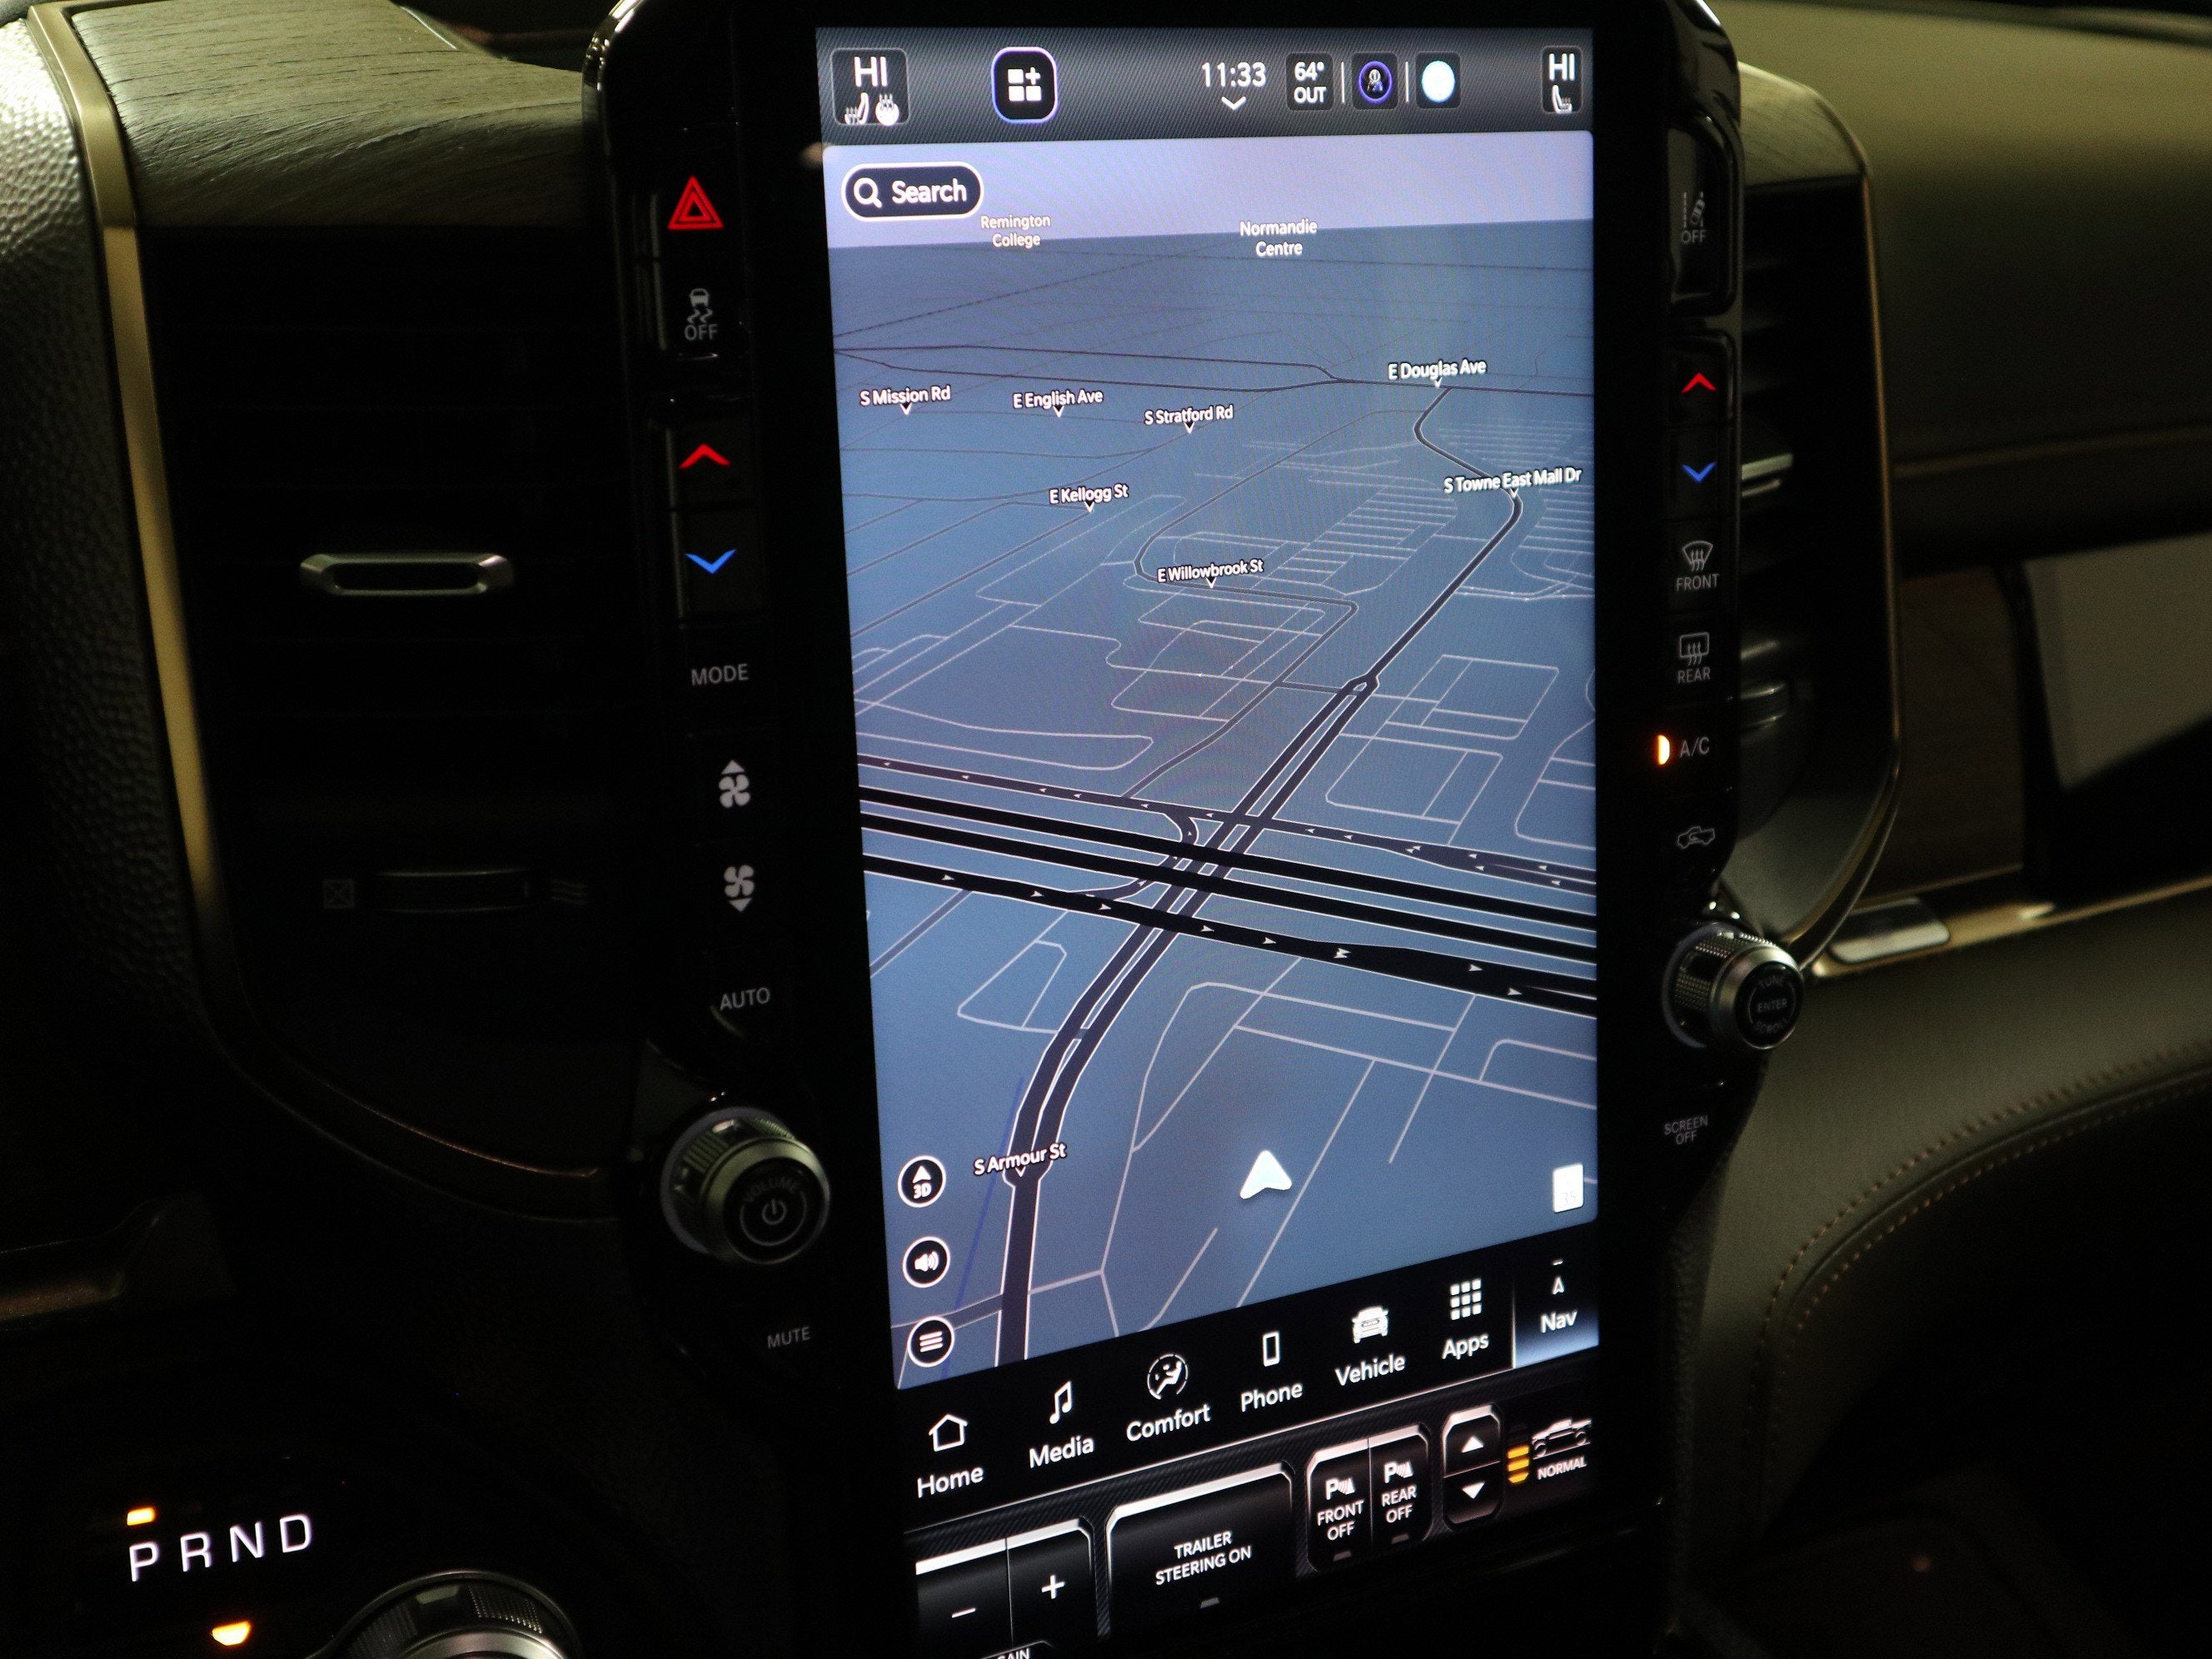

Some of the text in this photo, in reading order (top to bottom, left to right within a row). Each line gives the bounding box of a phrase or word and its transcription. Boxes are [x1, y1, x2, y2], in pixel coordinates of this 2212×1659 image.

[854, 56, 888, 87] HI
[1201, 62, 1267, 87] 11:33
[1293, 61, 1325, 81] 64°
[1549, 52, 1576, 81] HI
[1293, 85, 1327, 104] OUT
[891, 177, 967, 205] Search
[980, 214, 1051, 232] Remington
[1239, 218, 1318, 236] Normandie
[992, 232, 1041, 248] College
[1681, 229, 1707, 244] OFF
[1255, 241, 1303, 257] Centre
[684, 323, 718, 341] OFF
[1388, 359, 1487, 380] E Douglas Ave
[860, 386, 951, 406] S Mission Rd
[1013, 389, 1104, 410] E English Ave
[1144, 405, 1233, 425] S Stratford Rd
[1443, 467, 1582, 494] S Towne East Mall Dr
[1049, 483, 1128, 504] E Kellogg St
[1158, 559, 1263, 583] E Willowbrook St
[1676, 573, 1720, 591] FRONT
[690, 664, 749, 686] MODE
[1677, 666, 1711, 684] REAR
[1680, 736, 1710, 758] A/C
[720, 987, 771, 1010] AUTO
[1756, 998, 1788, 1014] ENTER
[1665, 1114, 1707, 1135] SCREEN
[1676, 1129, 1697, 1146] OFF
[973, 1142, 1067, 1177] S Armour St
[913, 1183, 932, 1199] 3D
[1540, 1310, 1578, 1333] Nav
[767, 1326, 810, 1349] MUTE
[1442, 1333, 1489, 1360] Apps
[1335, 1354, 1406, 1386] Vehicle
[1241, 1382, 1303, 1412] Phone
[1126, 1404, 1211, 1442] Comfort
[1029, 1436, 1095, 1469] Media
[1537, 1456, 1588, 1480] NORMAL
[917, 1467, 984, 1498] Home
[1382, 1485, 1417, 1507] REAR
[1317, 1499, 1365, 1527] FRONT
[1386, 1502, 1413, 1523] OFF
[1327, 1520, 1356, 1541] OFF
[1173, 1530, 1233, 1560] TRAILER
[1155, 1545, 1252, 1586] STEERING ON
